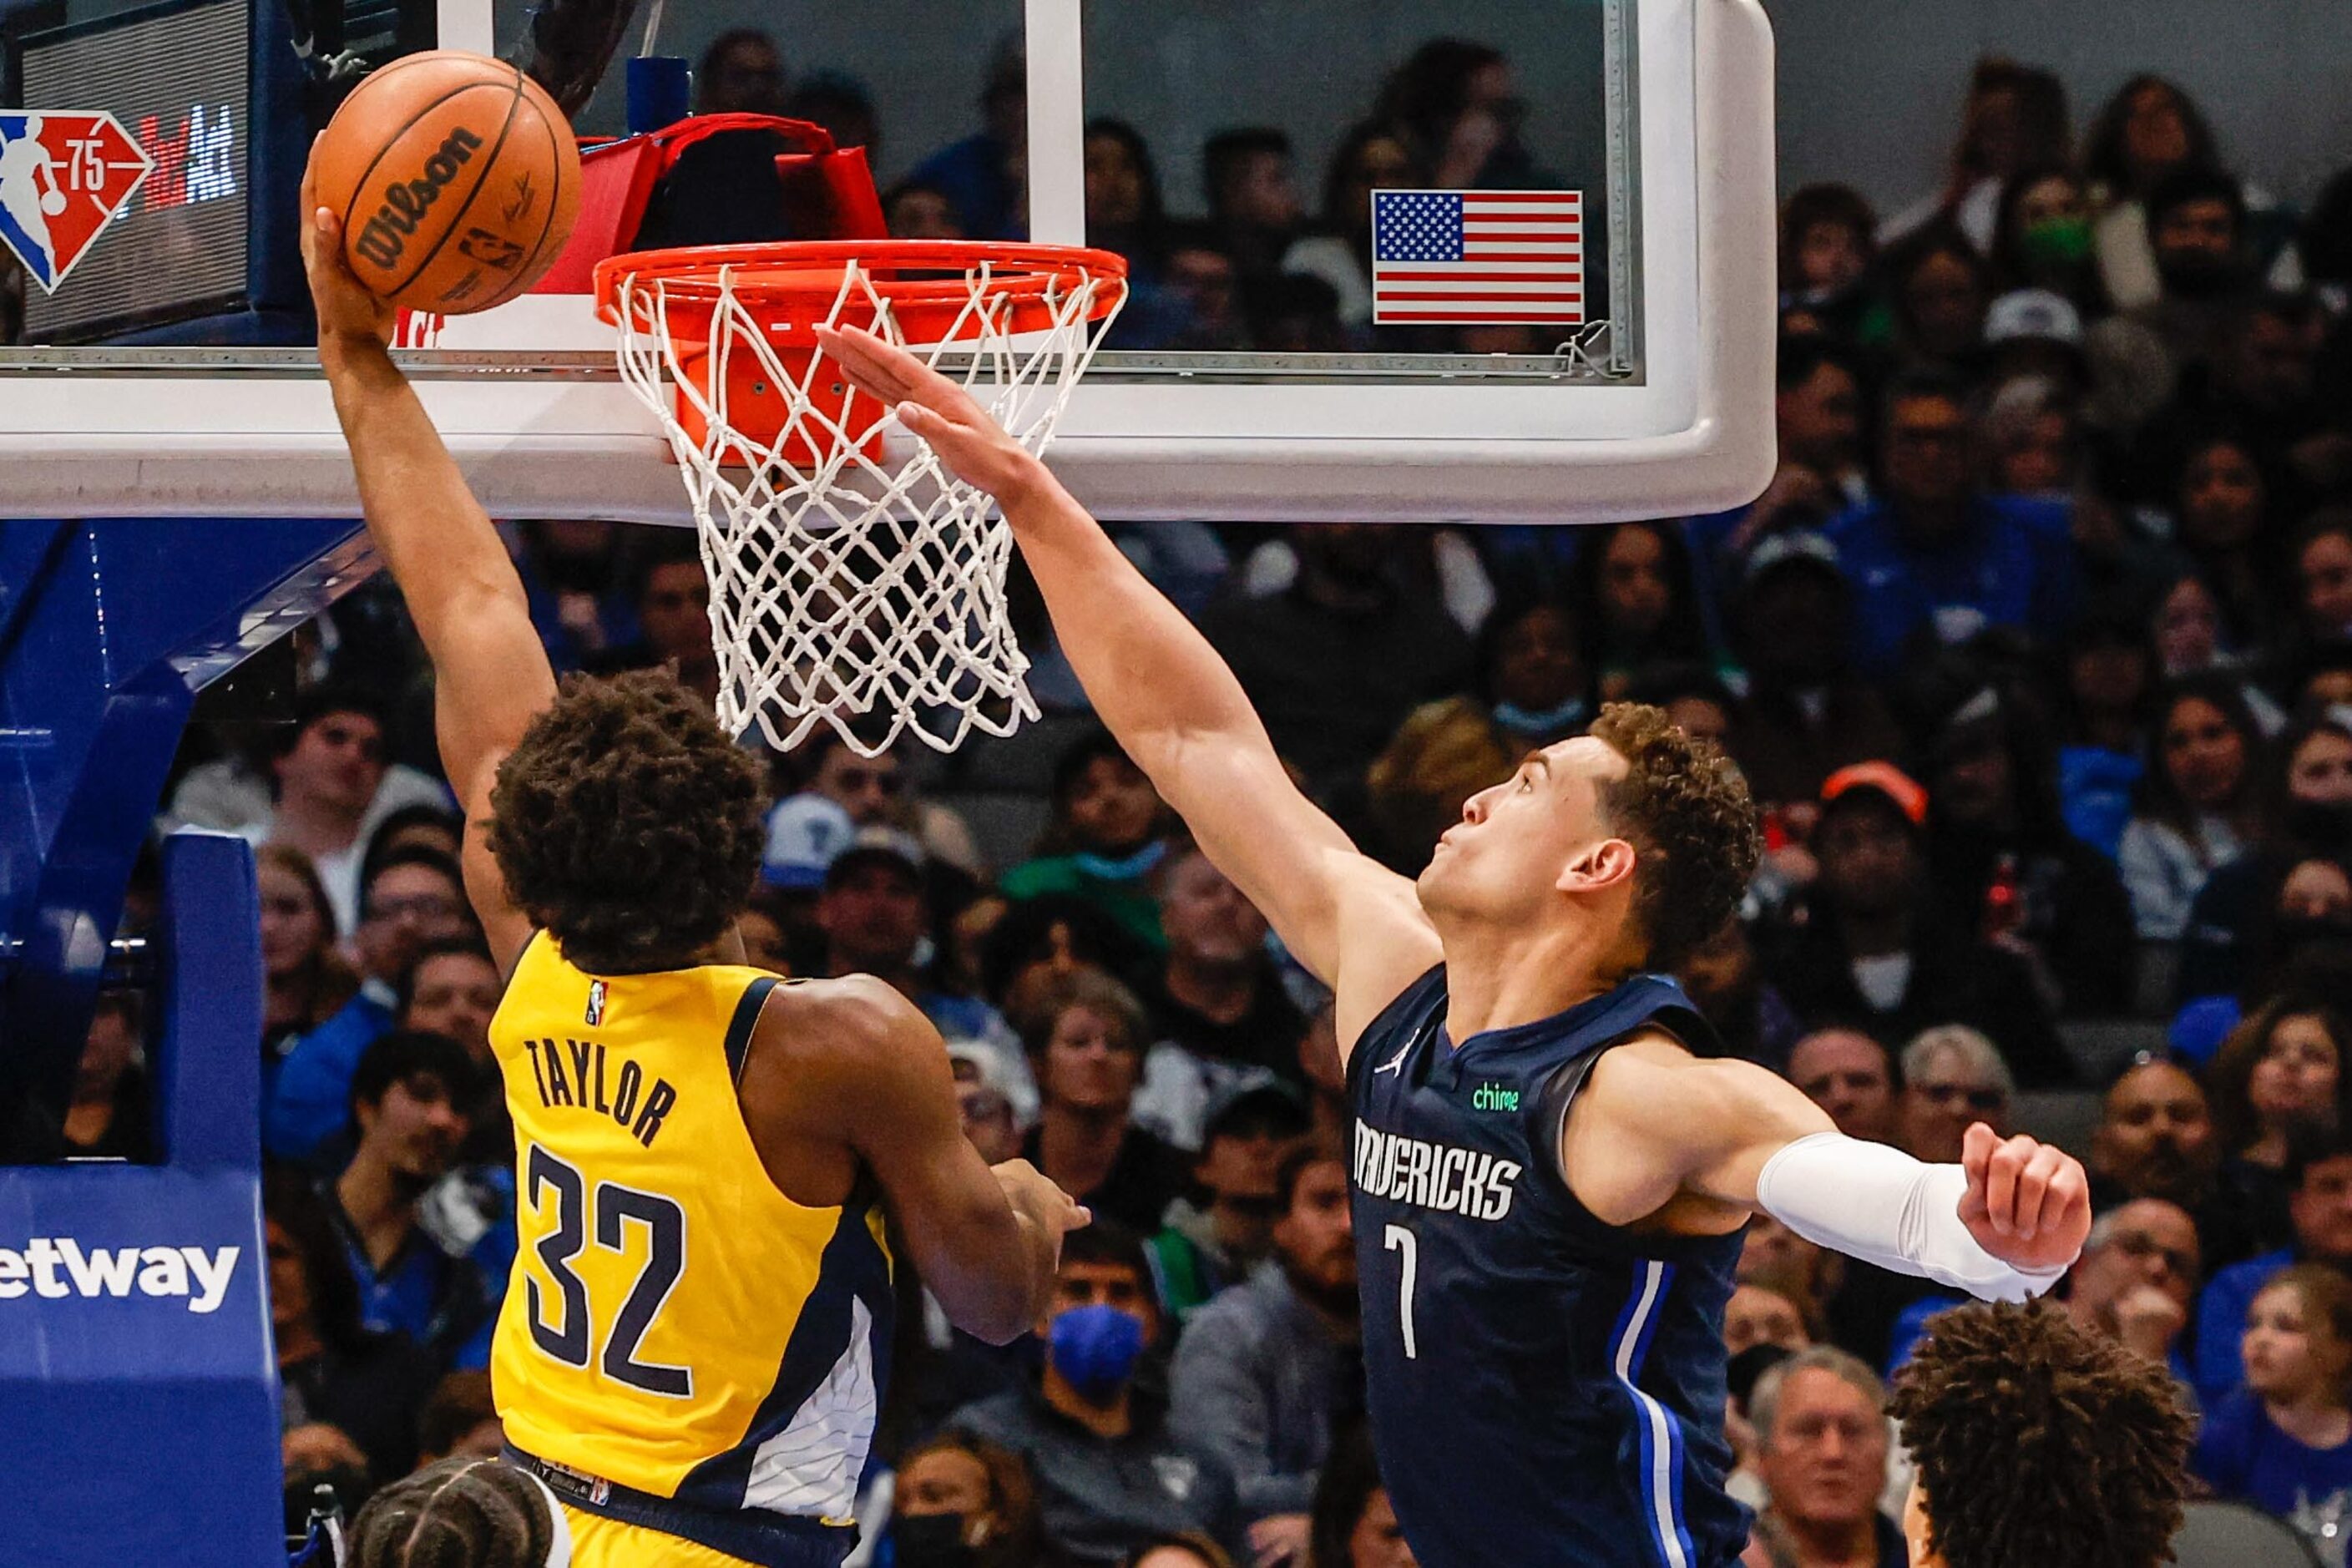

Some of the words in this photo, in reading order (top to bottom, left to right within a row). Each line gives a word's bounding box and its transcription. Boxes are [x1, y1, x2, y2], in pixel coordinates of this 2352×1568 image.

[66, 139, 104, 190] 75
[356, 126, 483, 271] Wilson
[524, 1038, 676, 1149] TAYLOR
[1473, 1081, 1519, 1112] chime
[1353, 1117, 1523, 1222] MAVERICKS
[524, 1141, 694, 1399] 32
[1384, 1224, 1417, 1360] 7
